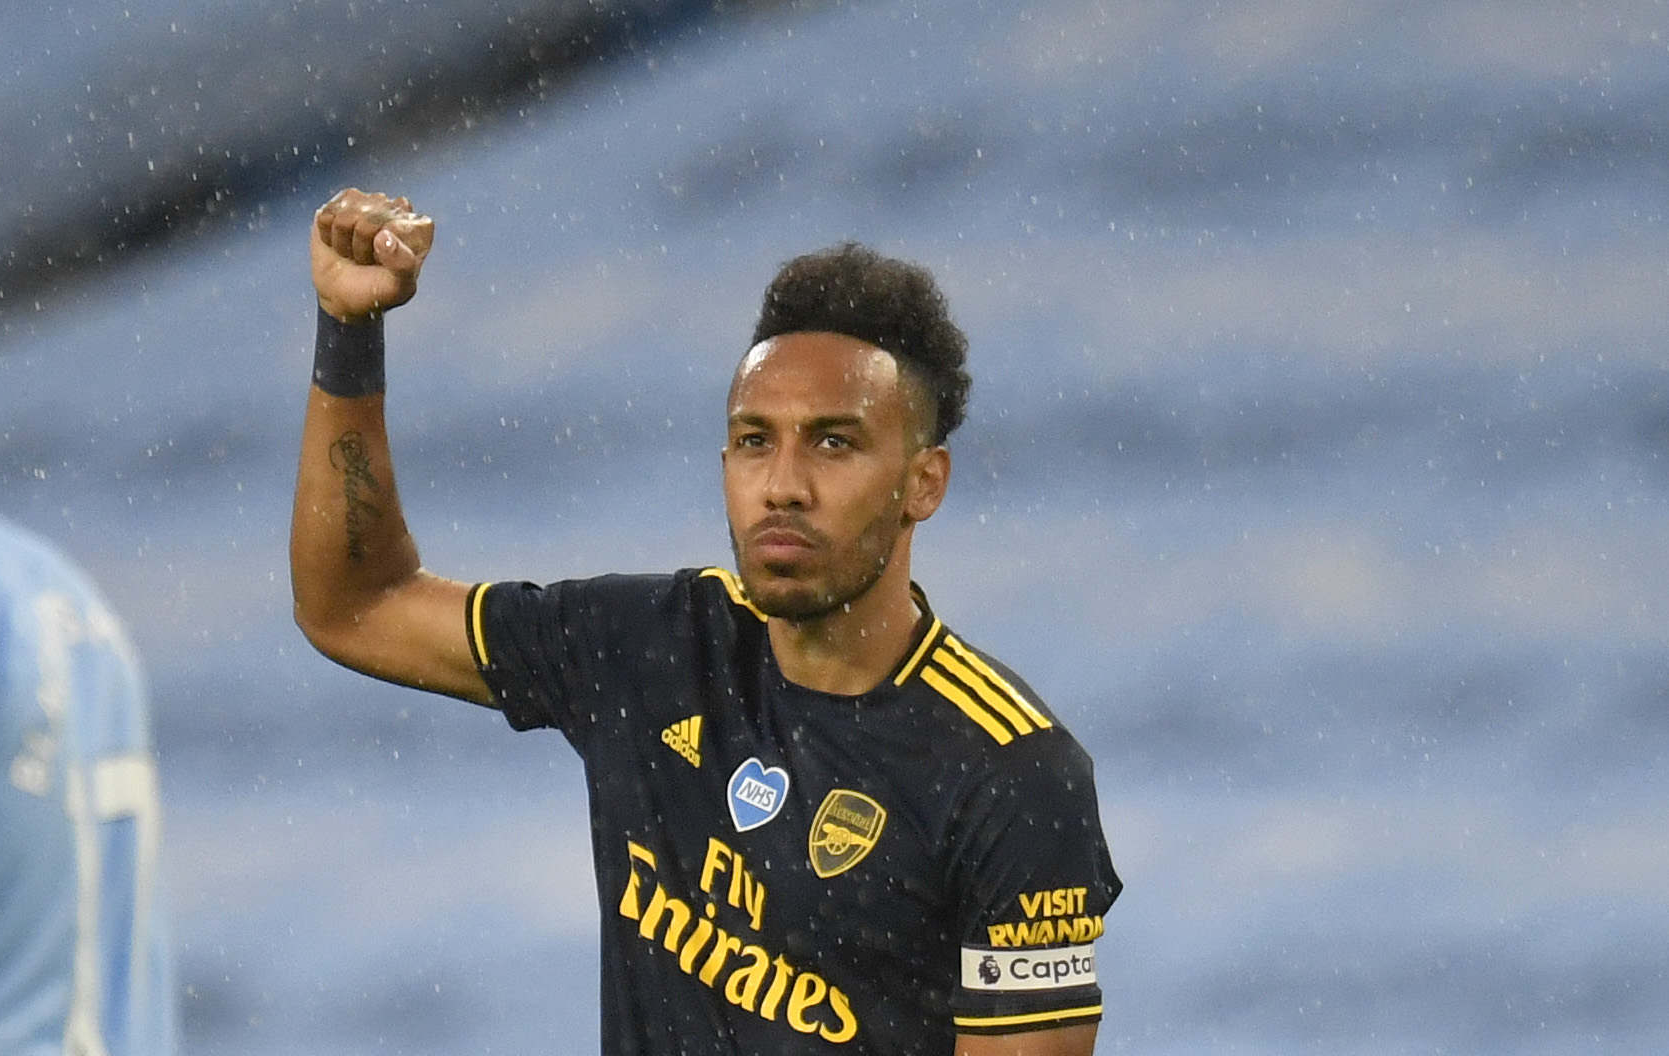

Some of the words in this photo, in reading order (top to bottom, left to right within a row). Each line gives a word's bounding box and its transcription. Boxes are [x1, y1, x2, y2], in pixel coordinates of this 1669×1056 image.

[661, 728, 702, 768] adidas
[739, 781, 774, 807] NHS
[700, 837, 766, 931] Fly
[1018, 887, 1088, 919] VISIT
